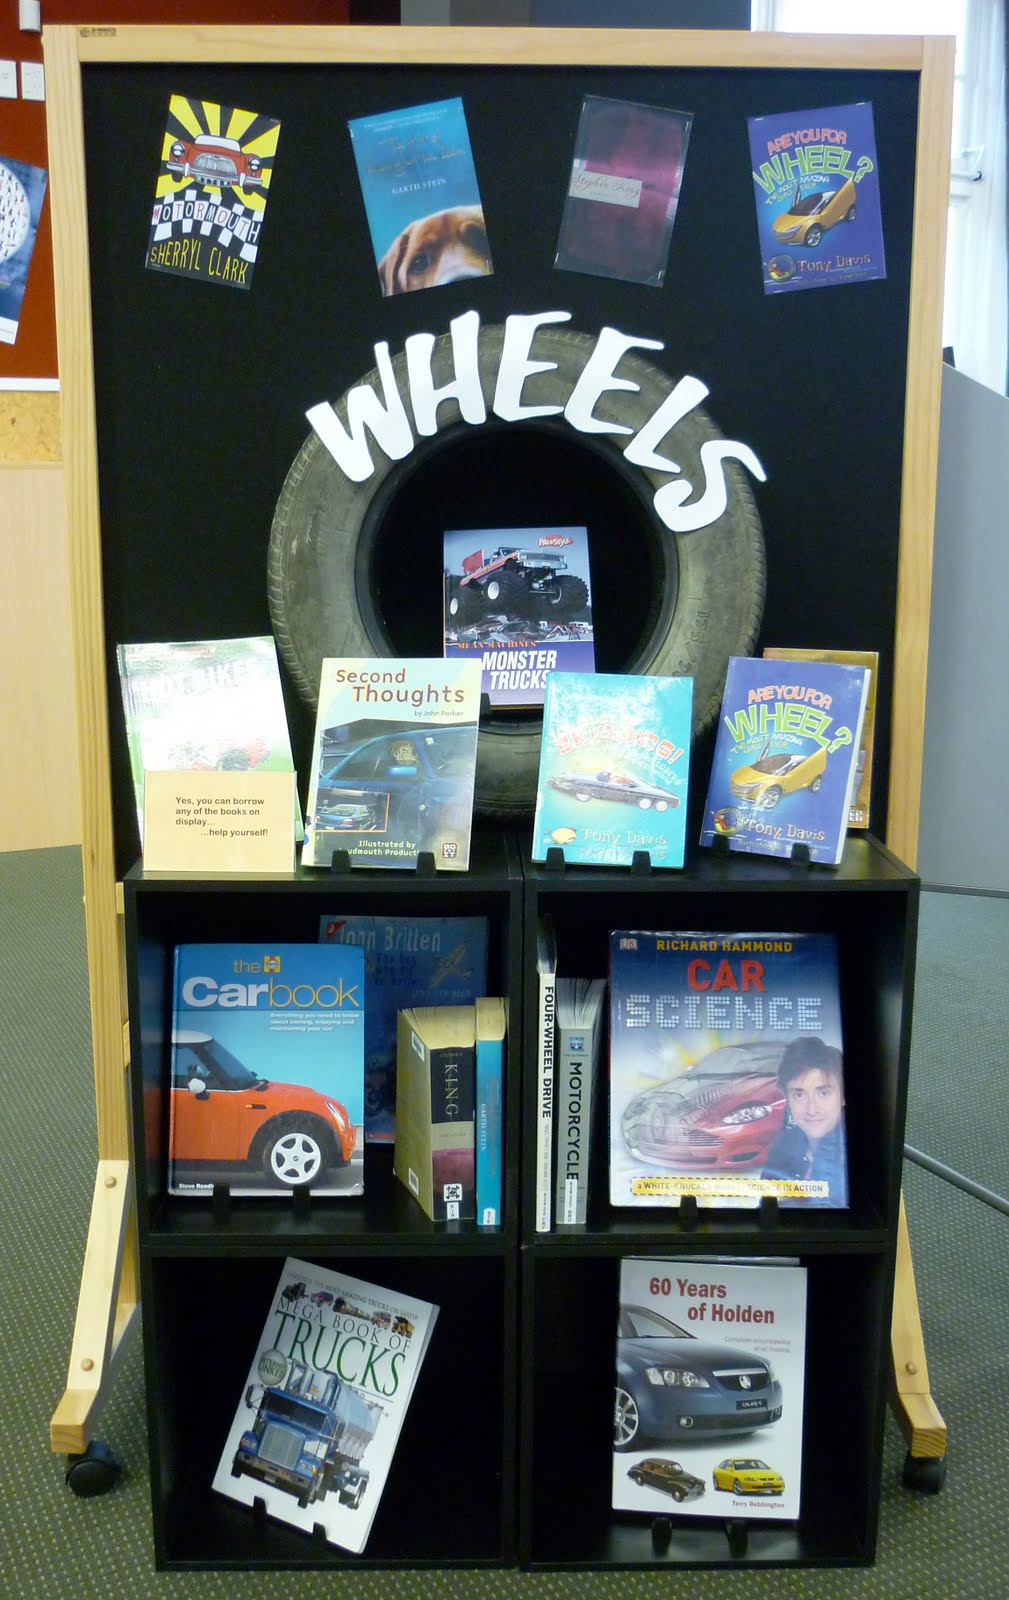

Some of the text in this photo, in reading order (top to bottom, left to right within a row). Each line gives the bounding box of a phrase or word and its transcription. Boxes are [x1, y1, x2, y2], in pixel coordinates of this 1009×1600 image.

[767, 128, 847, 155] ARE YOU FOR
[752, 145, 874, 194] WHEEL?
[799, 175, 830, 184] AMAZING
[391, 177, 447, 195] GARTH STEIN
[152, 201, 262, 244] MOTORMOUTH
[150, 237, 249, 284] SHERRYL CLARK
[800, 255, 870, 273] Tony Davis
[305, 310, 767, 532] WHEELS
[458, 641, 537, 650] MEAN MACHINES
[481, 650, 557, 671] MONSTER
[336, 668, 406, 684] Second
[353, 684, 465, 707] Thoughts
[748, 685, 833, 711] ARE YOU FOR
[414, 710, 464, 718] by John Parker
[724, 702, 853, 754] WHEEL?
[771, 733, 803, 746] AMAZING
[176, 797, 194, 805] Yes,
[197, 798, 213, 806] you
[233, 797, 264, 805] borrow
[230, 829, 268, 838] yourself!
[581, 828, 667, 845] Tony Davis
[747, 819, 825, 841] Tony Davis
[346, 848, 383, 856] udmouth
[358, 840, 416, 849] Illustrated by
[339, 925, 441, 952] John Britten
[656, 940, 793, 953] RICHARD HAMMOND
[232, 960, 261, 973] the
[687, 958, 767, 992] CAR
[626, 994, 823, 1030] SCIENCE
[543, 986, 554, 1075] FOUR-WHEEL
[445, 1064, 458, 1116] KING
[542, 1078, 552, 1118] DRIVE
[566, 1061, 582, 1180] MOTORCYCLE
[649, 1277, 727, 1299] 60 Years
[687, 1302, 775, 1324] of Holden
[276, 1297, 412, 1353] MEGA BOOK OF
[272, 1309, 406, 1397] TRUCKS
[732, 1500, 747, 1508] Terry
